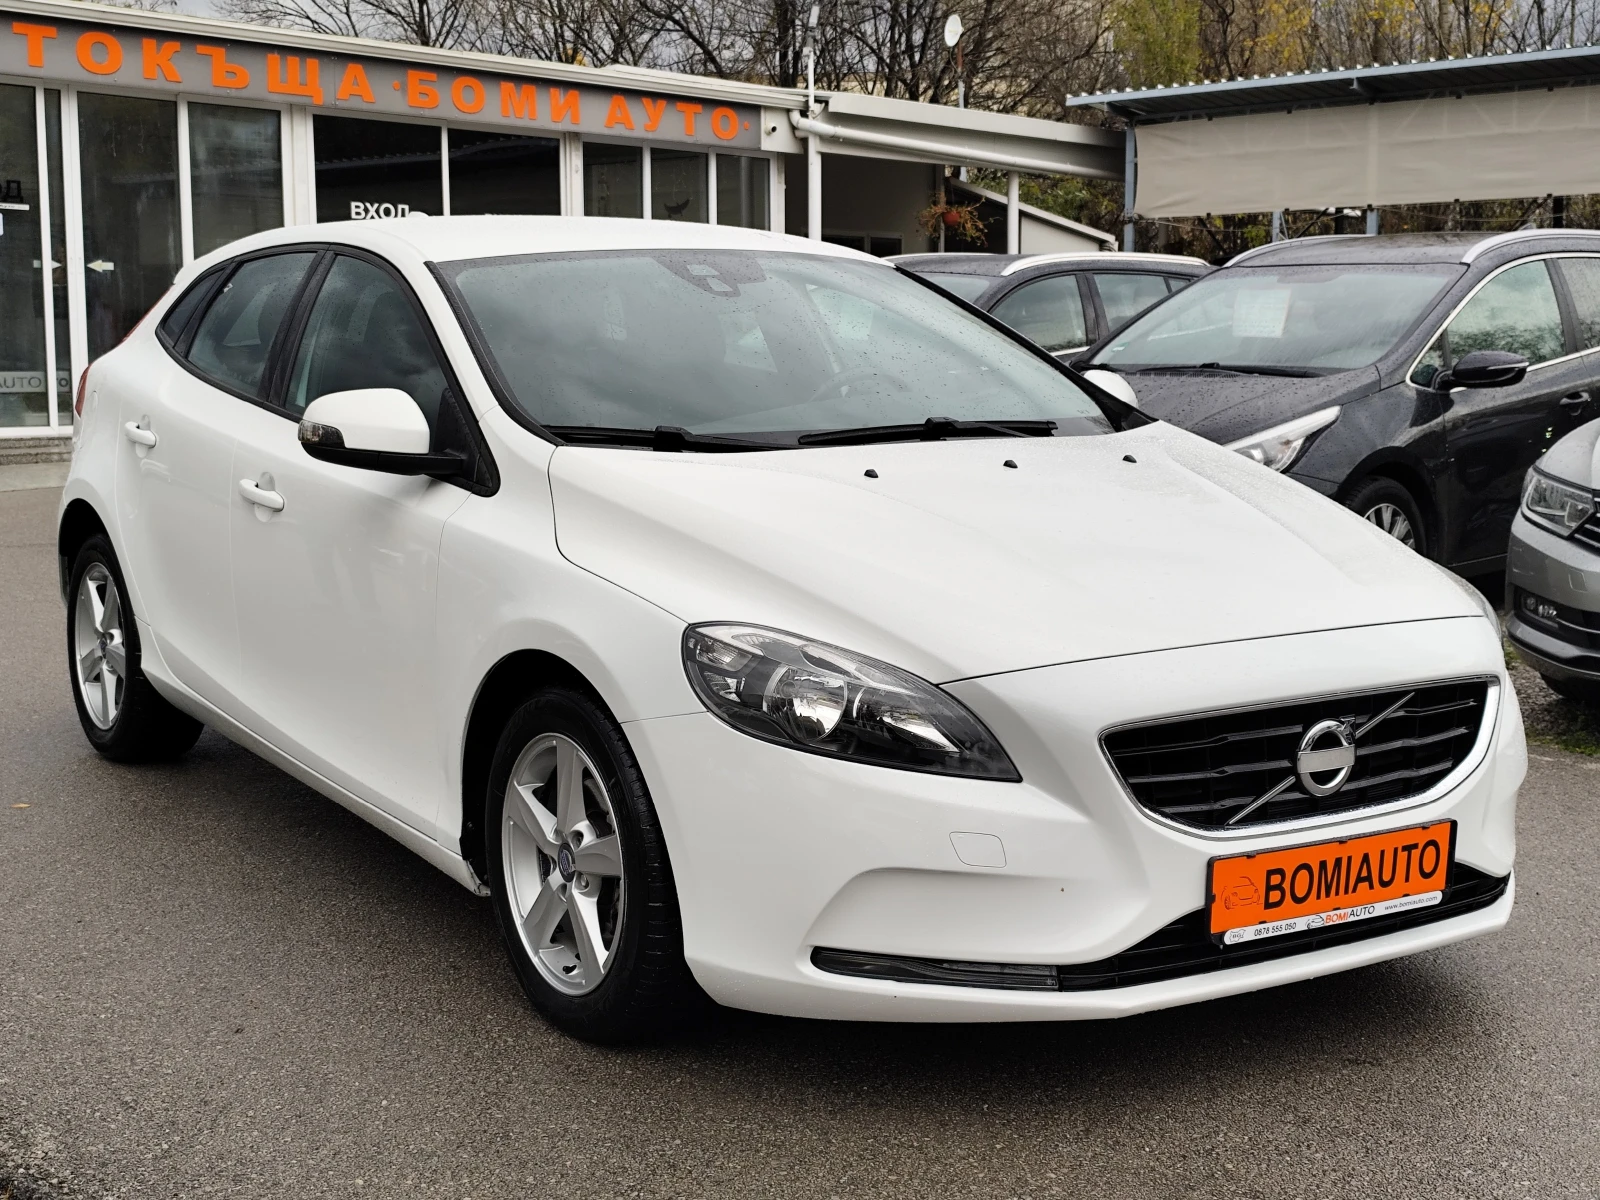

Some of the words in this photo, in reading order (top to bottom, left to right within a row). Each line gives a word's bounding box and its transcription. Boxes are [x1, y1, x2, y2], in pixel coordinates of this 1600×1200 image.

[406, 70, 581, 124] БОМИ
[604, 95, 738, 140] АУТО
[1264, 839, 1441, 910] BOMIAUTO
[1384, 896, 1438, 911] www.bomiauto.com
[1325, 905, 1375, 924] BOMIAUTO
[1254, 926, 1270, 936] 0878
[1271, 924, 1283, 933] 555
[1284, 922, 1297, 931] 050
